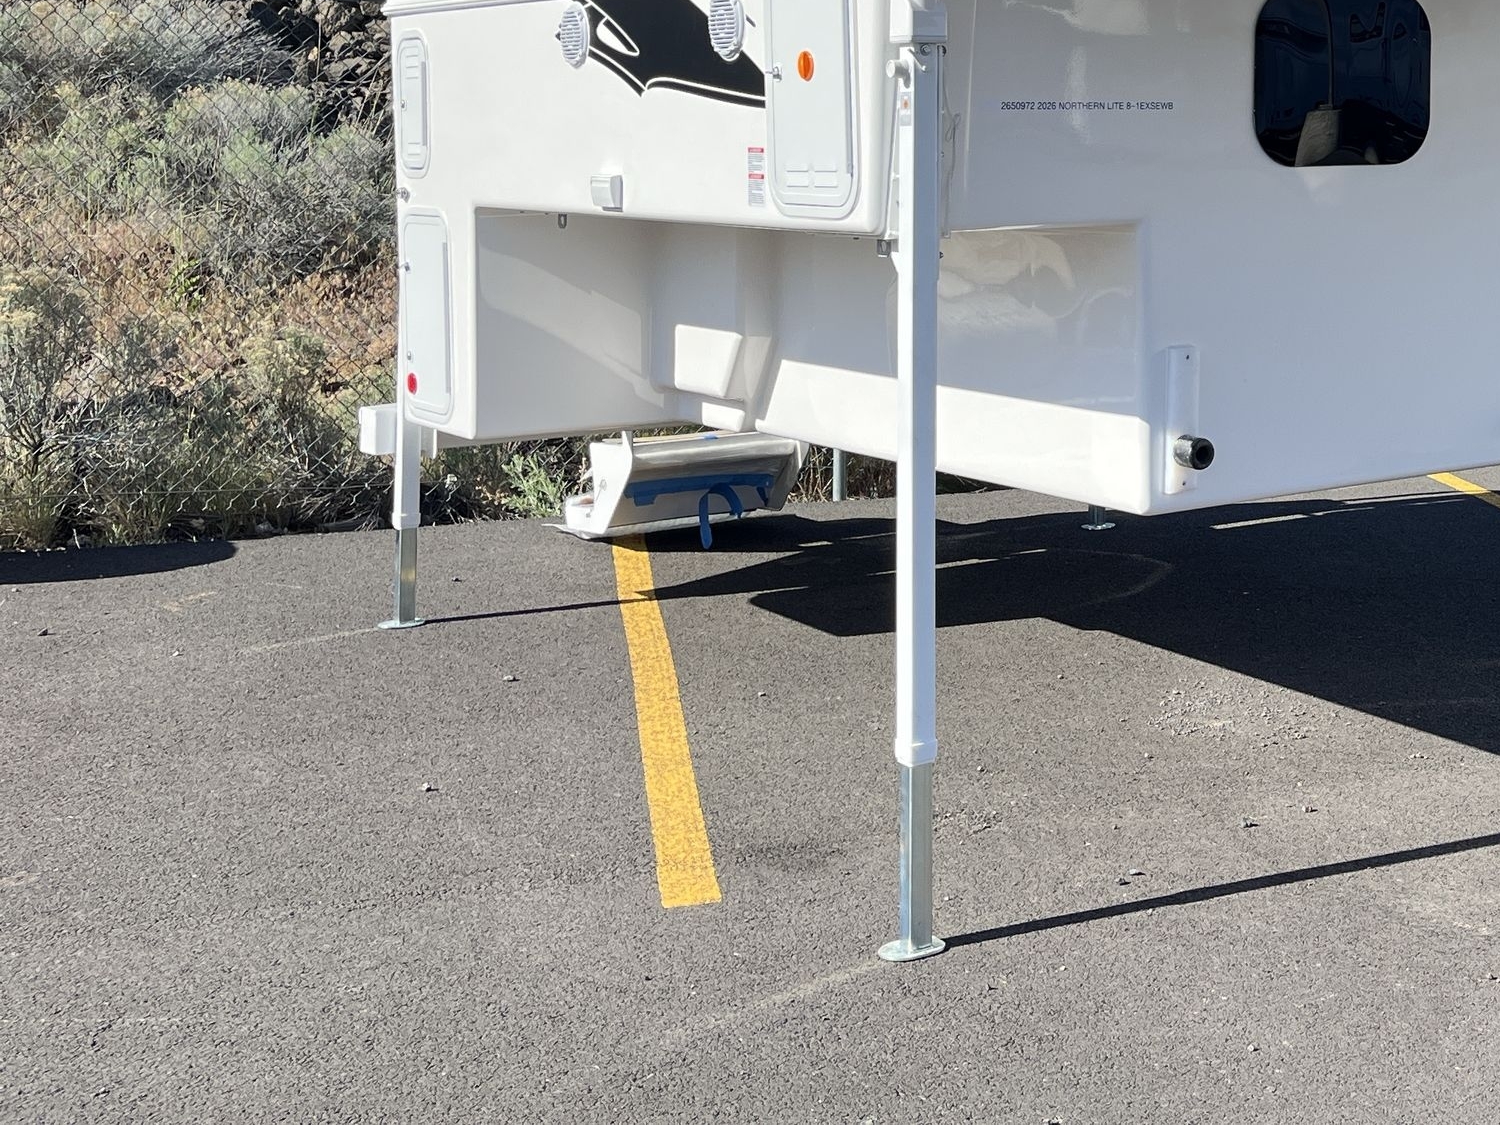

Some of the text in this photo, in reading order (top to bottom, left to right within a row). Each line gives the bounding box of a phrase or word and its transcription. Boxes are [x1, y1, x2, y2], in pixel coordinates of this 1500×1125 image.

[1000, 101, 1035, 111] 2650972
[1037, 101, 1057, 111] 2026
[1058, 101, 1105, 111] NORTHERN
[1107, 101, 1124, 111] LITE
